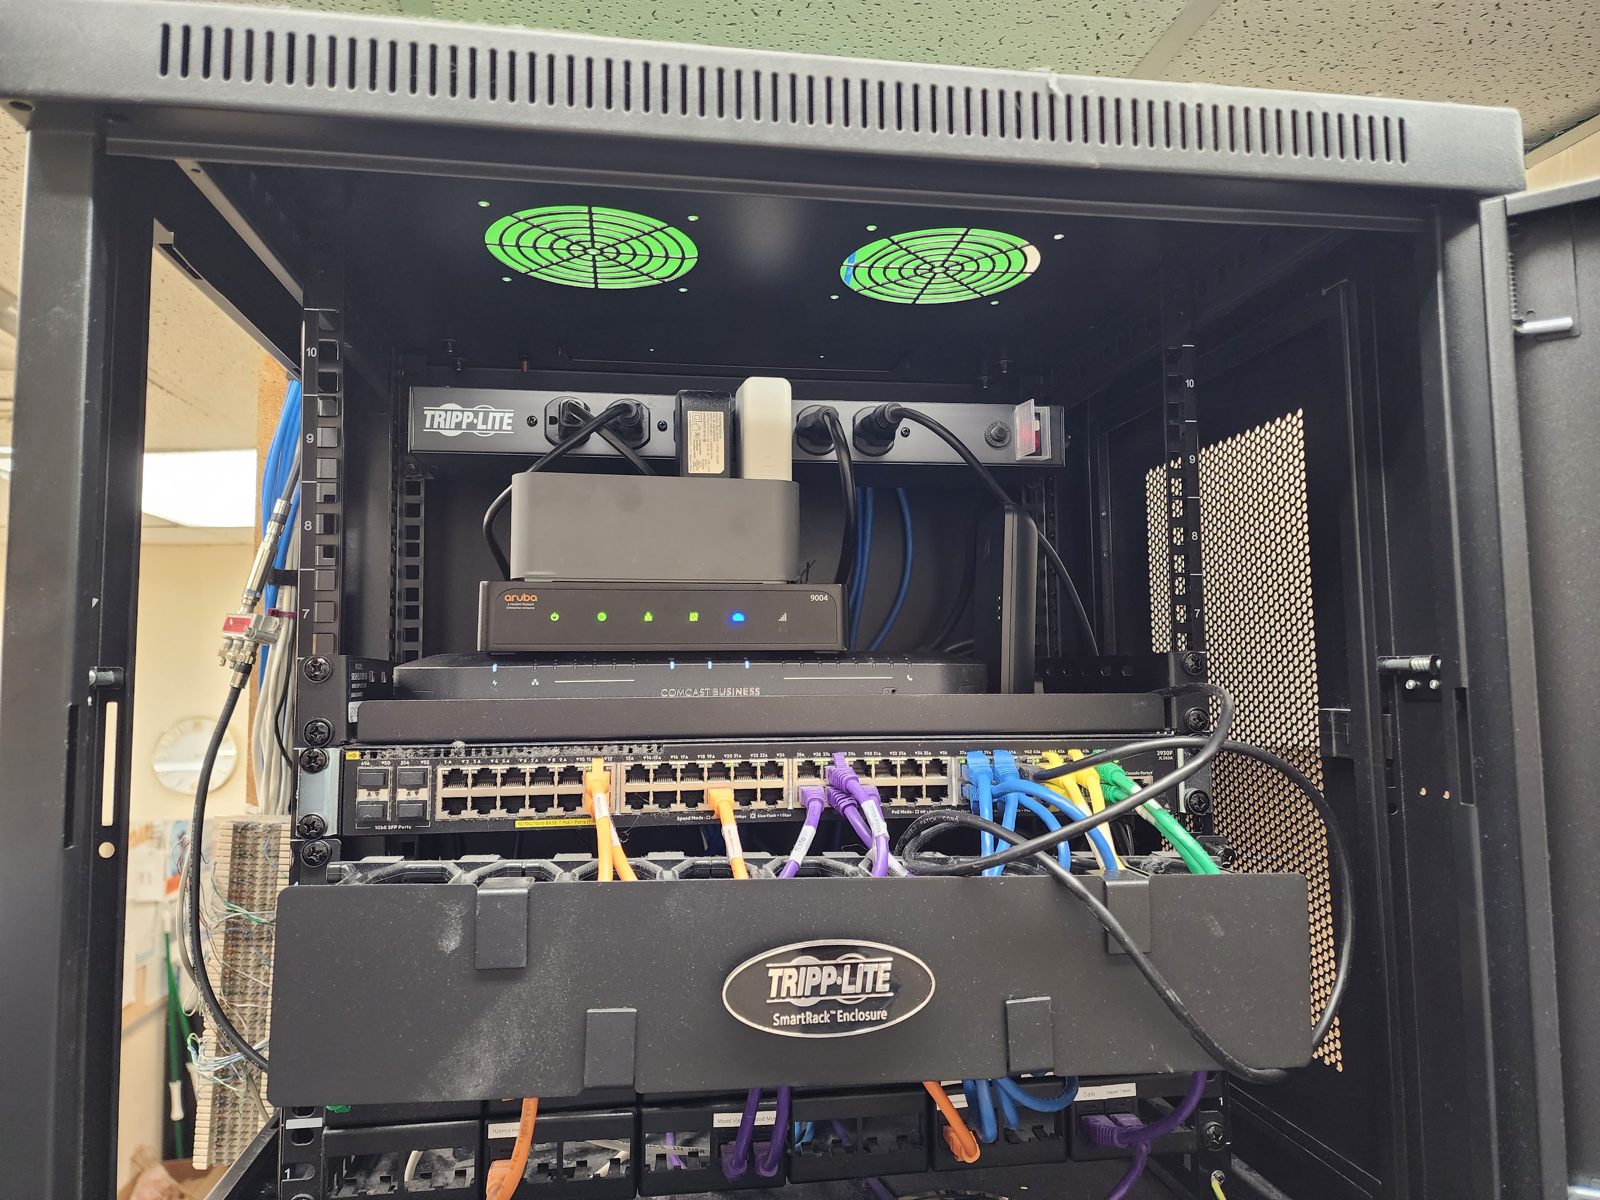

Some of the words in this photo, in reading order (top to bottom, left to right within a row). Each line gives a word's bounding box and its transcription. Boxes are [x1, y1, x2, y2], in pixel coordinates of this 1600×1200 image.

[306, 347, 317, 357] 10
[1185, 378, 1194, 388] 10
[305, 433, 314, 444] 9
[1189, 455, 1196, 464] 9
[304, 520, 313, 531] 8
[1191, 531, 1198, 541] 8
[504, 593, 538, 602] aruba
[810, 594, 828, 602] 9004
[302, 609, 310, 619] 7
[1194, 608, 1201, 618] 7
[660, 688, 711, 697] COMCAST
[712, 687, 761, 697] BUSINESS
[837, 1009, 888, 1023] Enclosure
[1218, 1096, 1224, 1106] 1
[284, 1168, 291, 1180] 1
